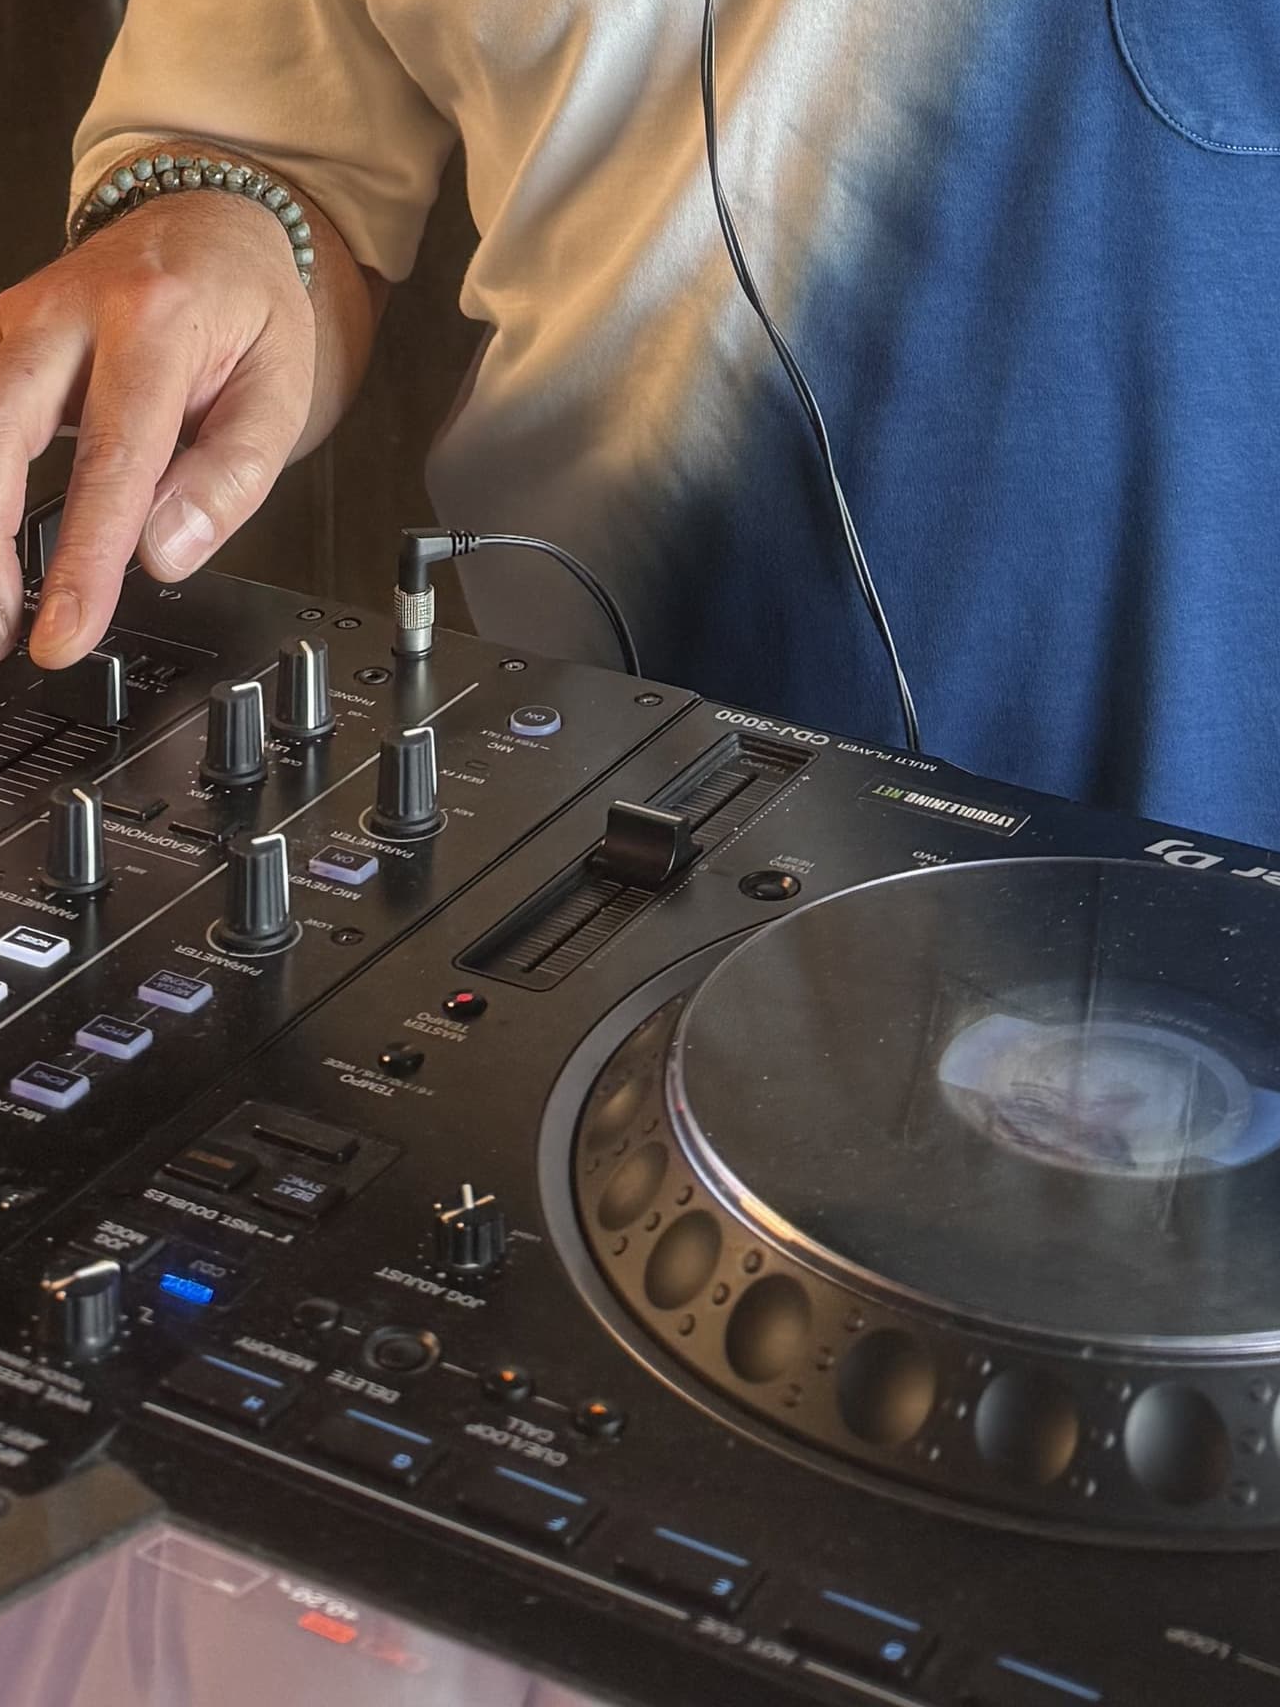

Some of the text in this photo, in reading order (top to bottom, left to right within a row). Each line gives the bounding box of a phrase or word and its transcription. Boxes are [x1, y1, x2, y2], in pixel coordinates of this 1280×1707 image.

[524, 710, 547, 723] ON
[714, 708, 831, 746] CDJ-3000
[486, 740, 514, 753] MIC
[837, 741, 938, 773] MULTI PLAYER
[187, 788, 214, 801] MIX
[870, 784, 1016, 829] LYDUDLEJNING.NET
[329, 830, 415, 860] PARAMETER
[1143, 839, 1225, 870] DJ
[331, 852, 355, 865] ON
[768, 859, 811, 875] TEMPO
[777, 853, 816, 869] RESET
[911, 850, 949, 864] FWD
[331, 886, 362, 902] MIC
[303, 917, 334, 931] LOW
[13, 933, 53, 949] NOISE
[174, 944, 264, 977] PARAMETER
[403, 1018, 468, 1043] MASTER
[416, 1011, 471, 1033] TEMPO
[33, 1070, 69, 1087] ECHO
[339, 1074, 396, 1098] TEMPO
[13, 1106, 47, 1124] MIC
[272, 1182, 318, 1203] BEAT
[281, 1173, 326, 1193] SYNC
[143, 1187, 219, 1221] DOUBLES
[92, 1233, 131, 1250] JOG
[95, 1219, 149, 1244] MODE
[372, 1266, 487, 1310] JOG ADJUST
[232, 1337, 318, 1372] MEMORY
[324, 1368, 401, 1404] DELETE
[241, 1395, 265, 1411] H
[507, 1416, 556, 1444] CALL
[389, 1452, 414, 1470] G
